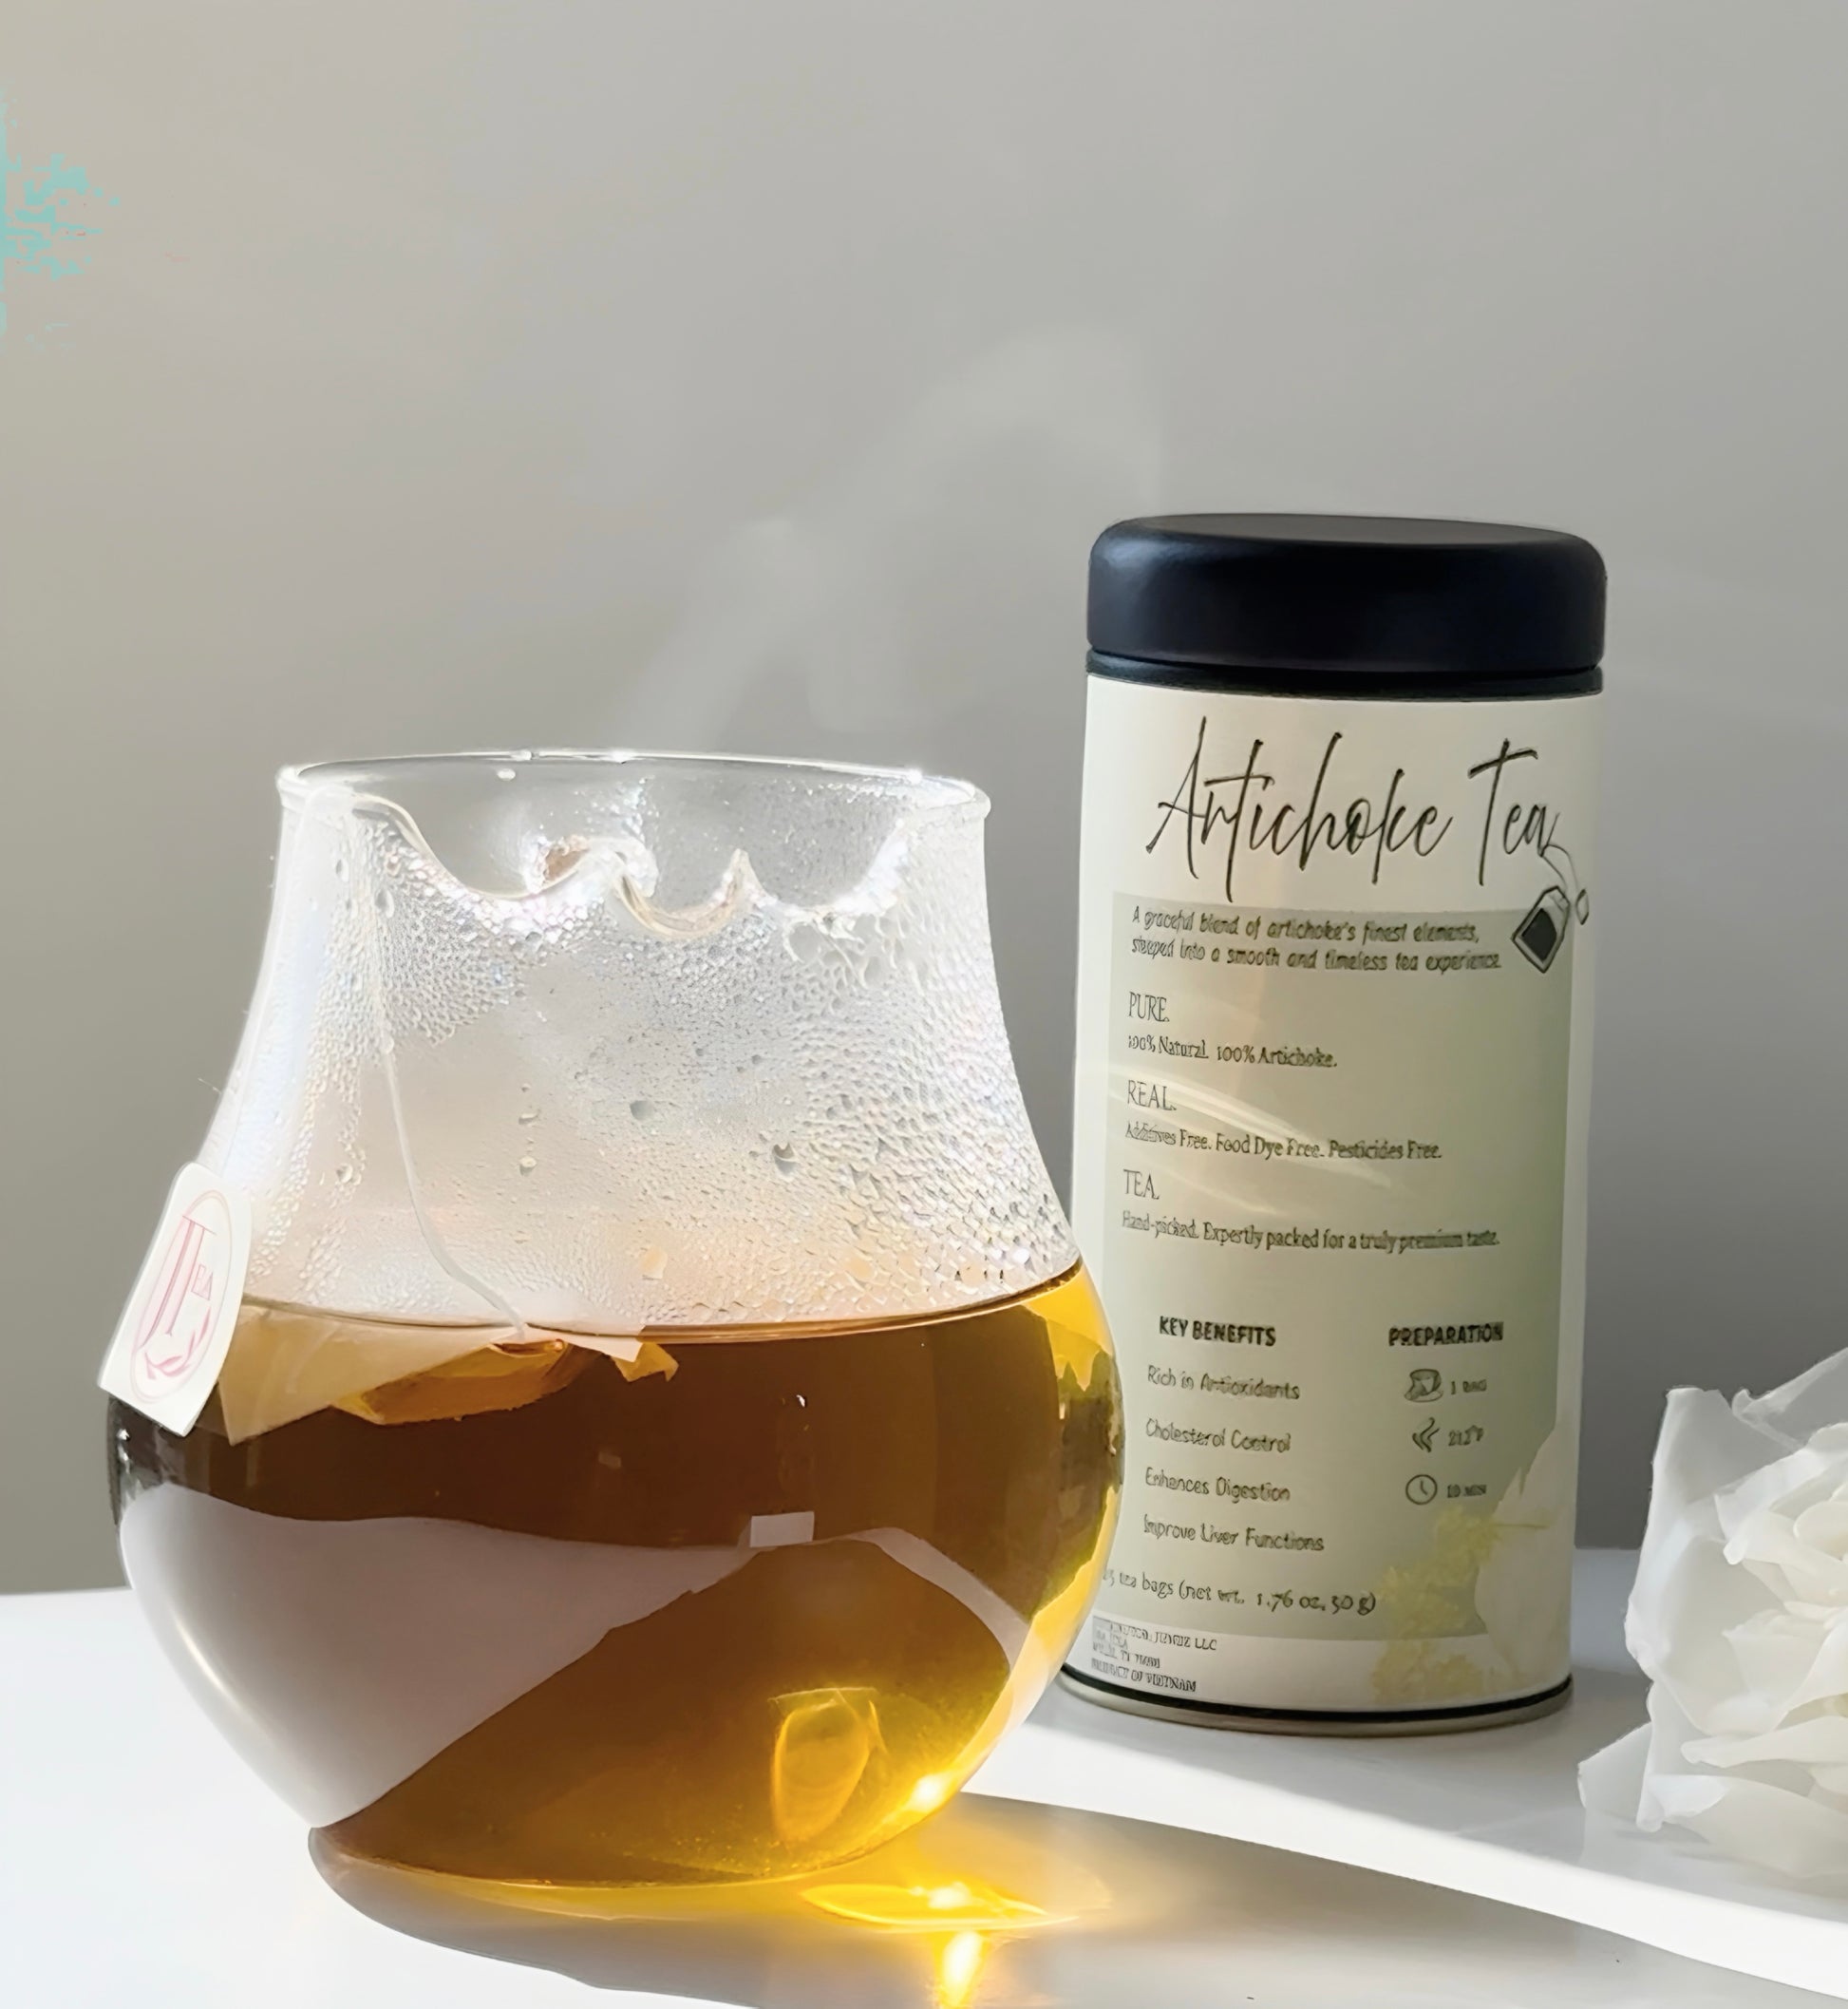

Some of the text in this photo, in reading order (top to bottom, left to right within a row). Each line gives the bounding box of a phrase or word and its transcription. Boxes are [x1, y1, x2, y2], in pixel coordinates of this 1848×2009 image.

[1145, 716, 1560, 902] Artichoke Tea
[1133, 905, 1140, 924] A
[1144, 910, 1195, 934] graceful
[1199, 913, 1239, 935] blend
[1246, 916, 1261, 940] of
[1267, 918, 1356, 940] artichoke's
[1362, 920, 1407, 945] finest
[1179, 938, 1206, 960] into
[1211, 948, 1220, 961] a
[1227, 946, 1279, 967] smooth
[1287, 950, 1317, 969] and
[1325, 949, 1387, 971] timeless
[1396, 952, 1419, 971] tea
[1128, 991, 1170, 1022] PURE.
[1128, 1034, 1156, 1052] 100%
[1217, 1045, 1255, 1064] 100%
[1257, 1046, 1338, 1068] Artichoke.
[1127, 1080, 1177, 1111] REAL.
[1179, 1128, 1212, 1149] Free.
[1216, 1132, 1250, 1153] Food
[1254, 1136, 1283, 1161] Dye
[1286, 1137, 1325, 1158] Free.
[1329, 1139, 1403, 1160] Pesticides
[1406, 1140, 1443, 1160] Free.
[1123, 1168, 1160, 1201] TEA.
[1202, 1222, 1263, 1249] Expertly
[1266, 1226, 1319, 1251] packed
[1322, 1229, 1344, 1250] for
[1348, 1236, 1357, 1249] a
[1360, 1230, 1394, 1254] truly
[1160, 1316, 1276, 1347] KEY BENEFITS
[1388, 1321, 1504, 1347] PREPARATION
[1147, 1365, 1300, 1400] Rich in Antioxidants
[1145, 1418, 1292, 1453] Cholesterol Control
[1145, 1467, 1291, 1504] Enhances Digestion
[1143, 1513, 1325, 1551] Improve Liver Functions
[1142, 1571, 1174, 1600] bags
[1179, 1579, 1212, 1601] (net
[1257, 1589, 1293, 1613] 1.76
[1357, 1592, 1376, 1616] g)
